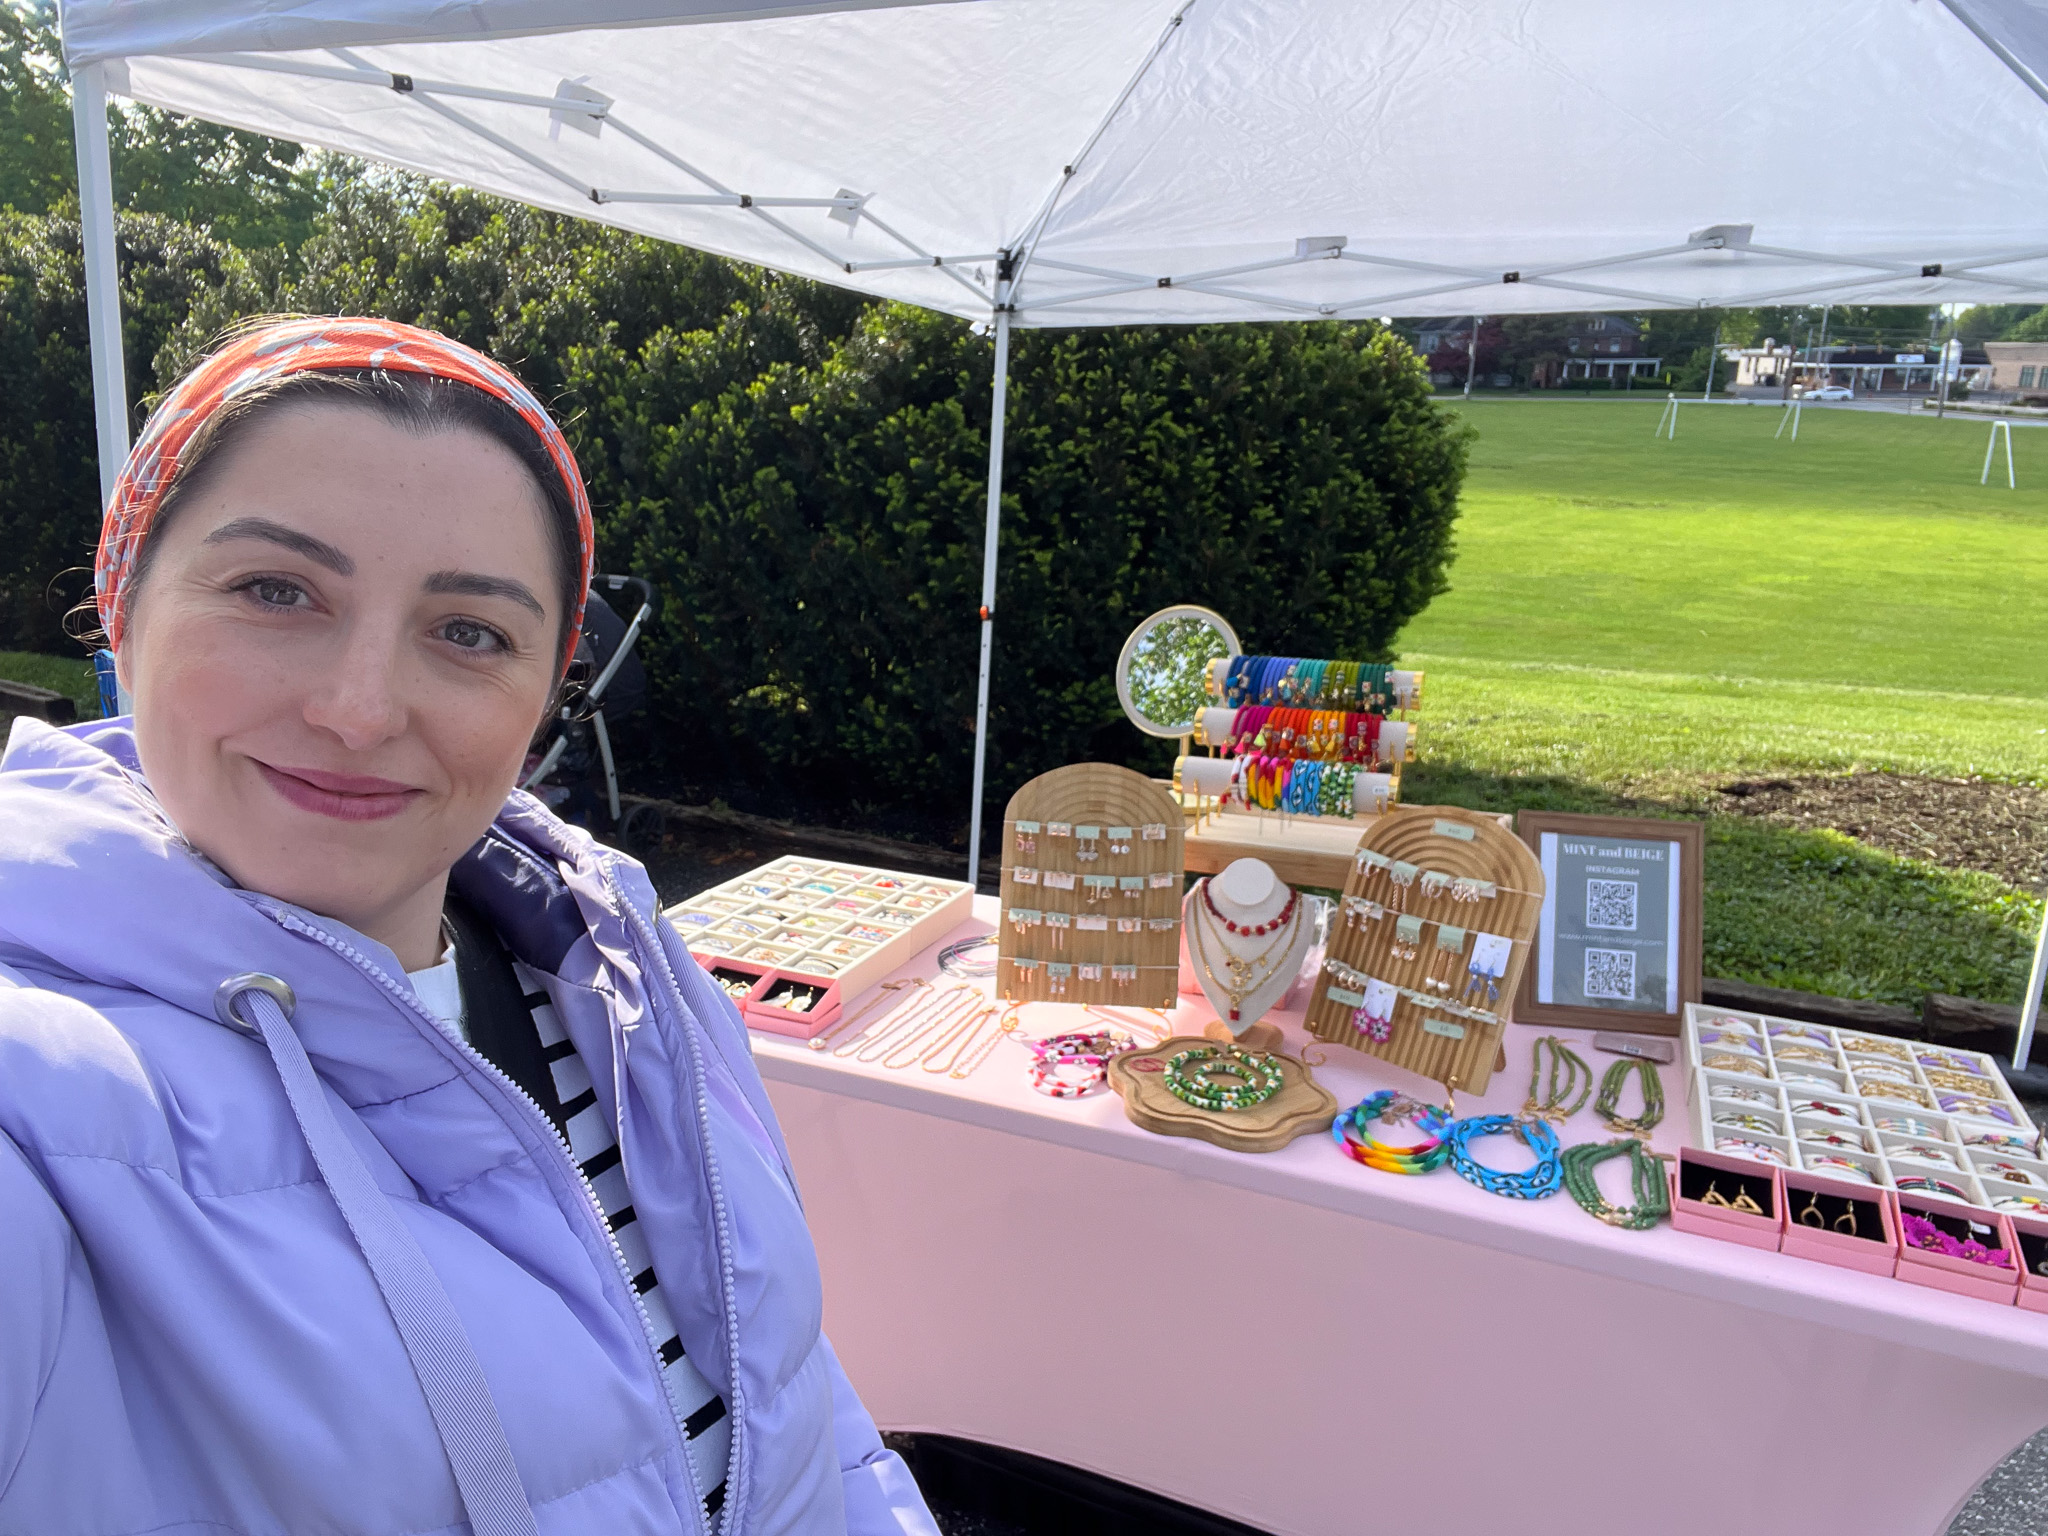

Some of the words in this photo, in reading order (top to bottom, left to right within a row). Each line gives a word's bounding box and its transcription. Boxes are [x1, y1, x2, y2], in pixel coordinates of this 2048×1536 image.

[1563, 843, 1597, 856] MINT
[1598, 847, 1622, 858] and
[1624, 847, 1664, 860] BEIGE
[1586, 865, 1640, 875] INSTAGRAM
